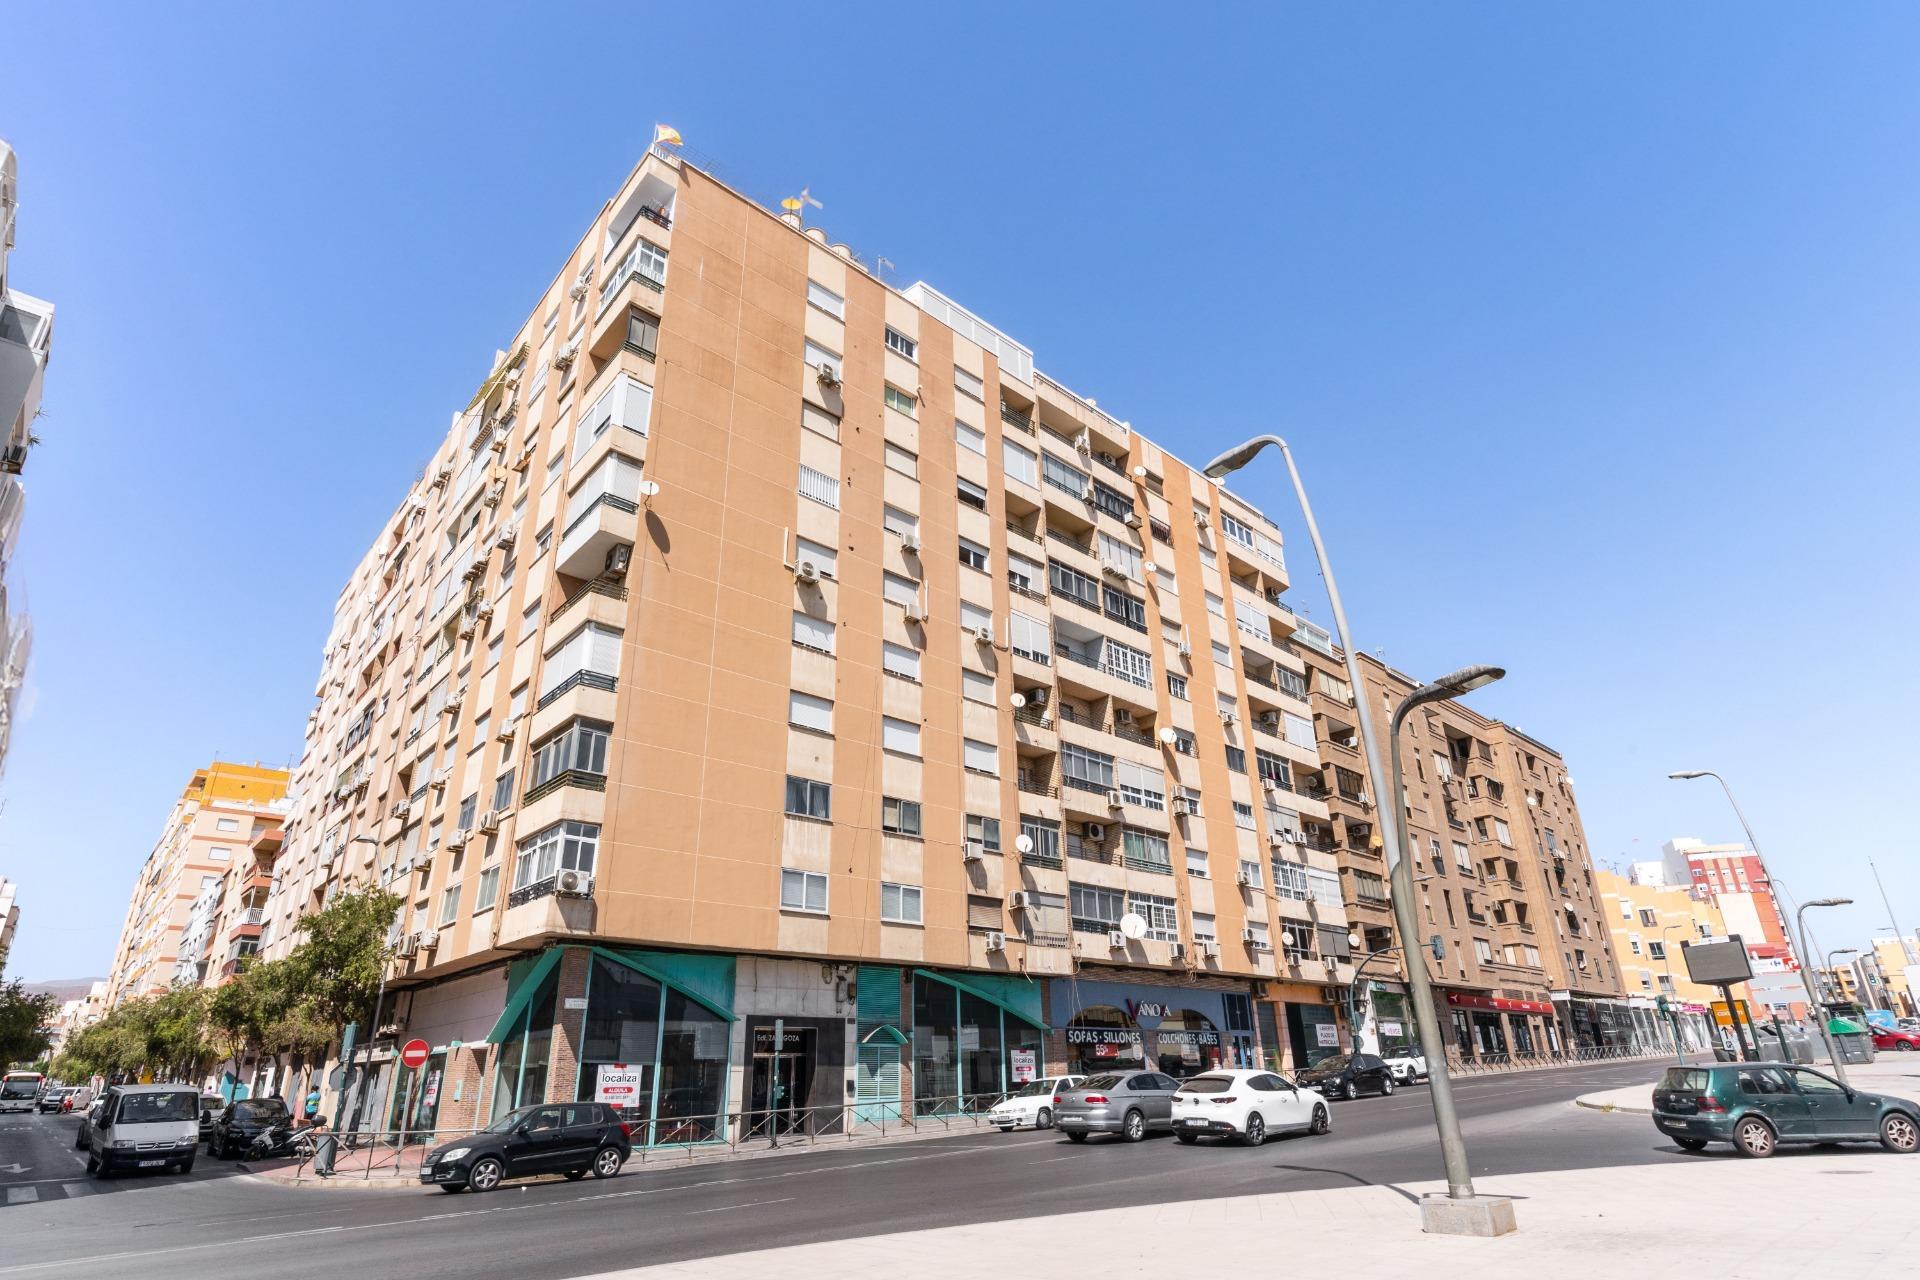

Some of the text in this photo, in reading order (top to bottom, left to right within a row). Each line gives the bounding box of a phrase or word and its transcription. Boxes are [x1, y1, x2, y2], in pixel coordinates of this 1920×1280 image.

[1068, 1031, 1141, 1044] SOFAS SILLONES
[1158, 1033, 1218, 1045] COLCHONES BASES
[602, 1073, 637, 1083] localiza
